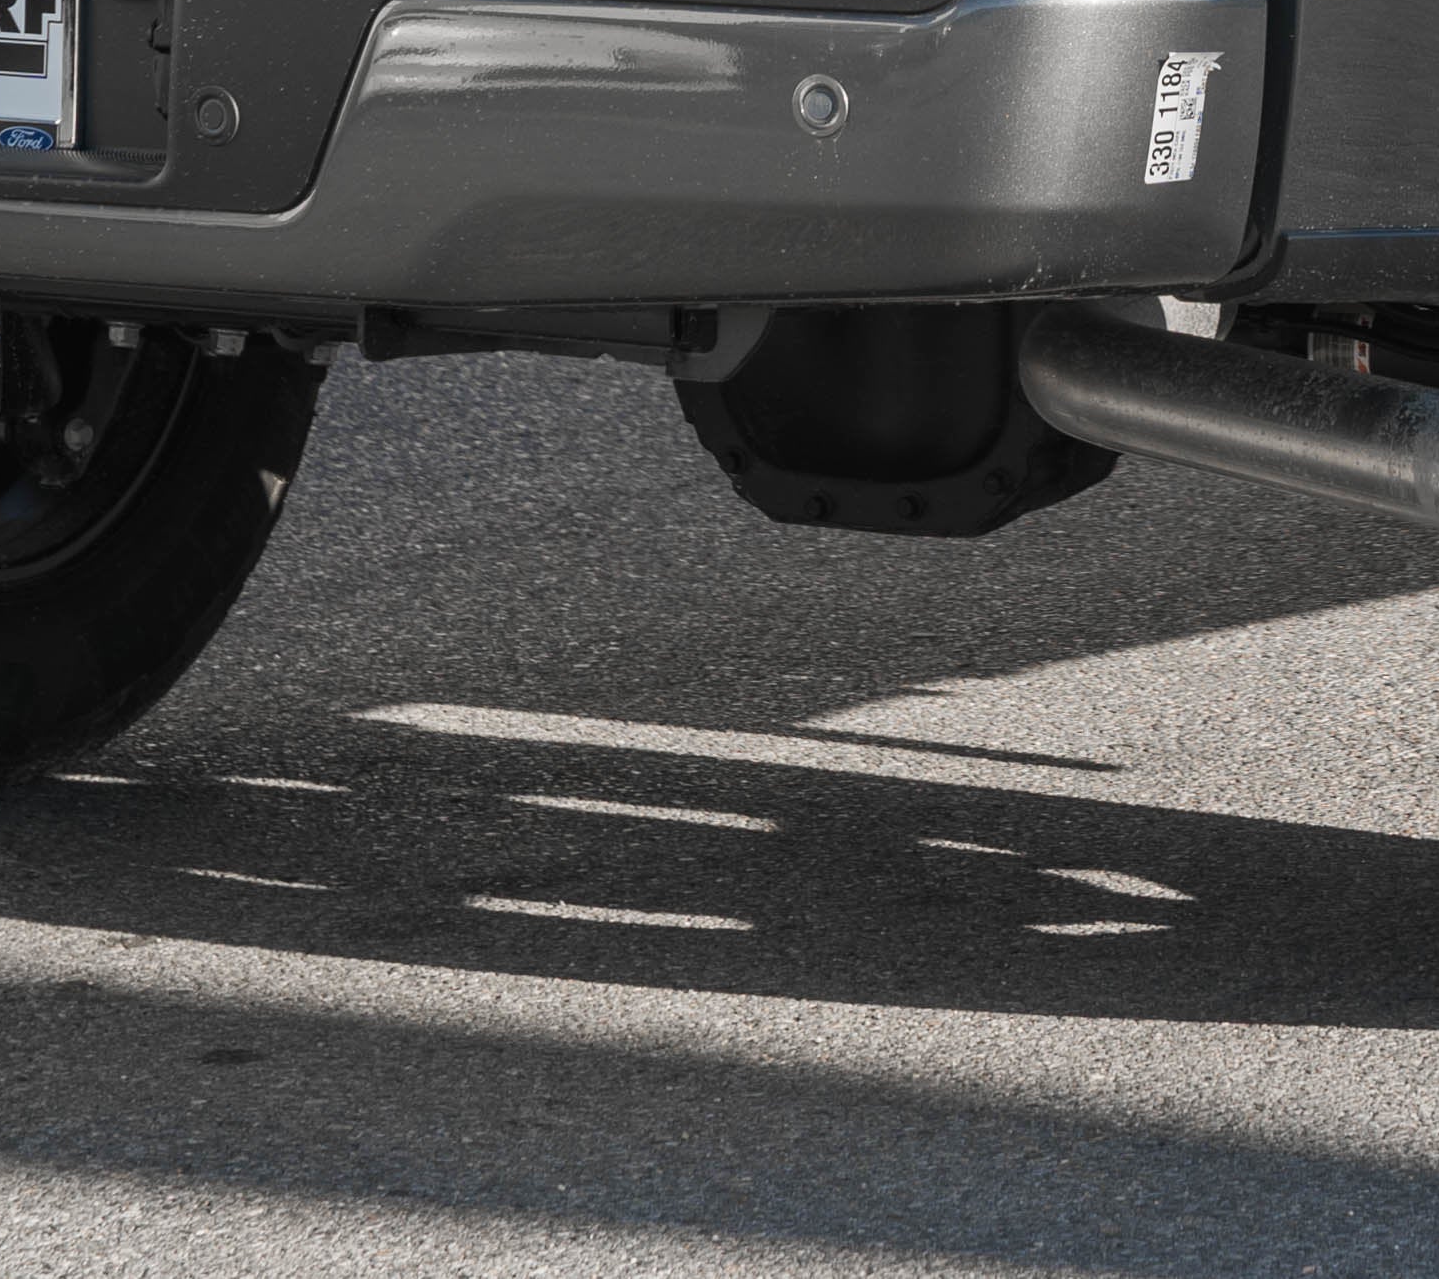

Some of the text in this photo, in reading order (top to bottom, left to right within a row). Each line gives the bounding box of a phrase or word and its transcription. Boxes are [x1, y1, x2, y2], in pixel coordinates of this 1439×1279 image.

[6, 129, 46, 150] Ford
[1149, 59, 1189, 177] 330 1184
